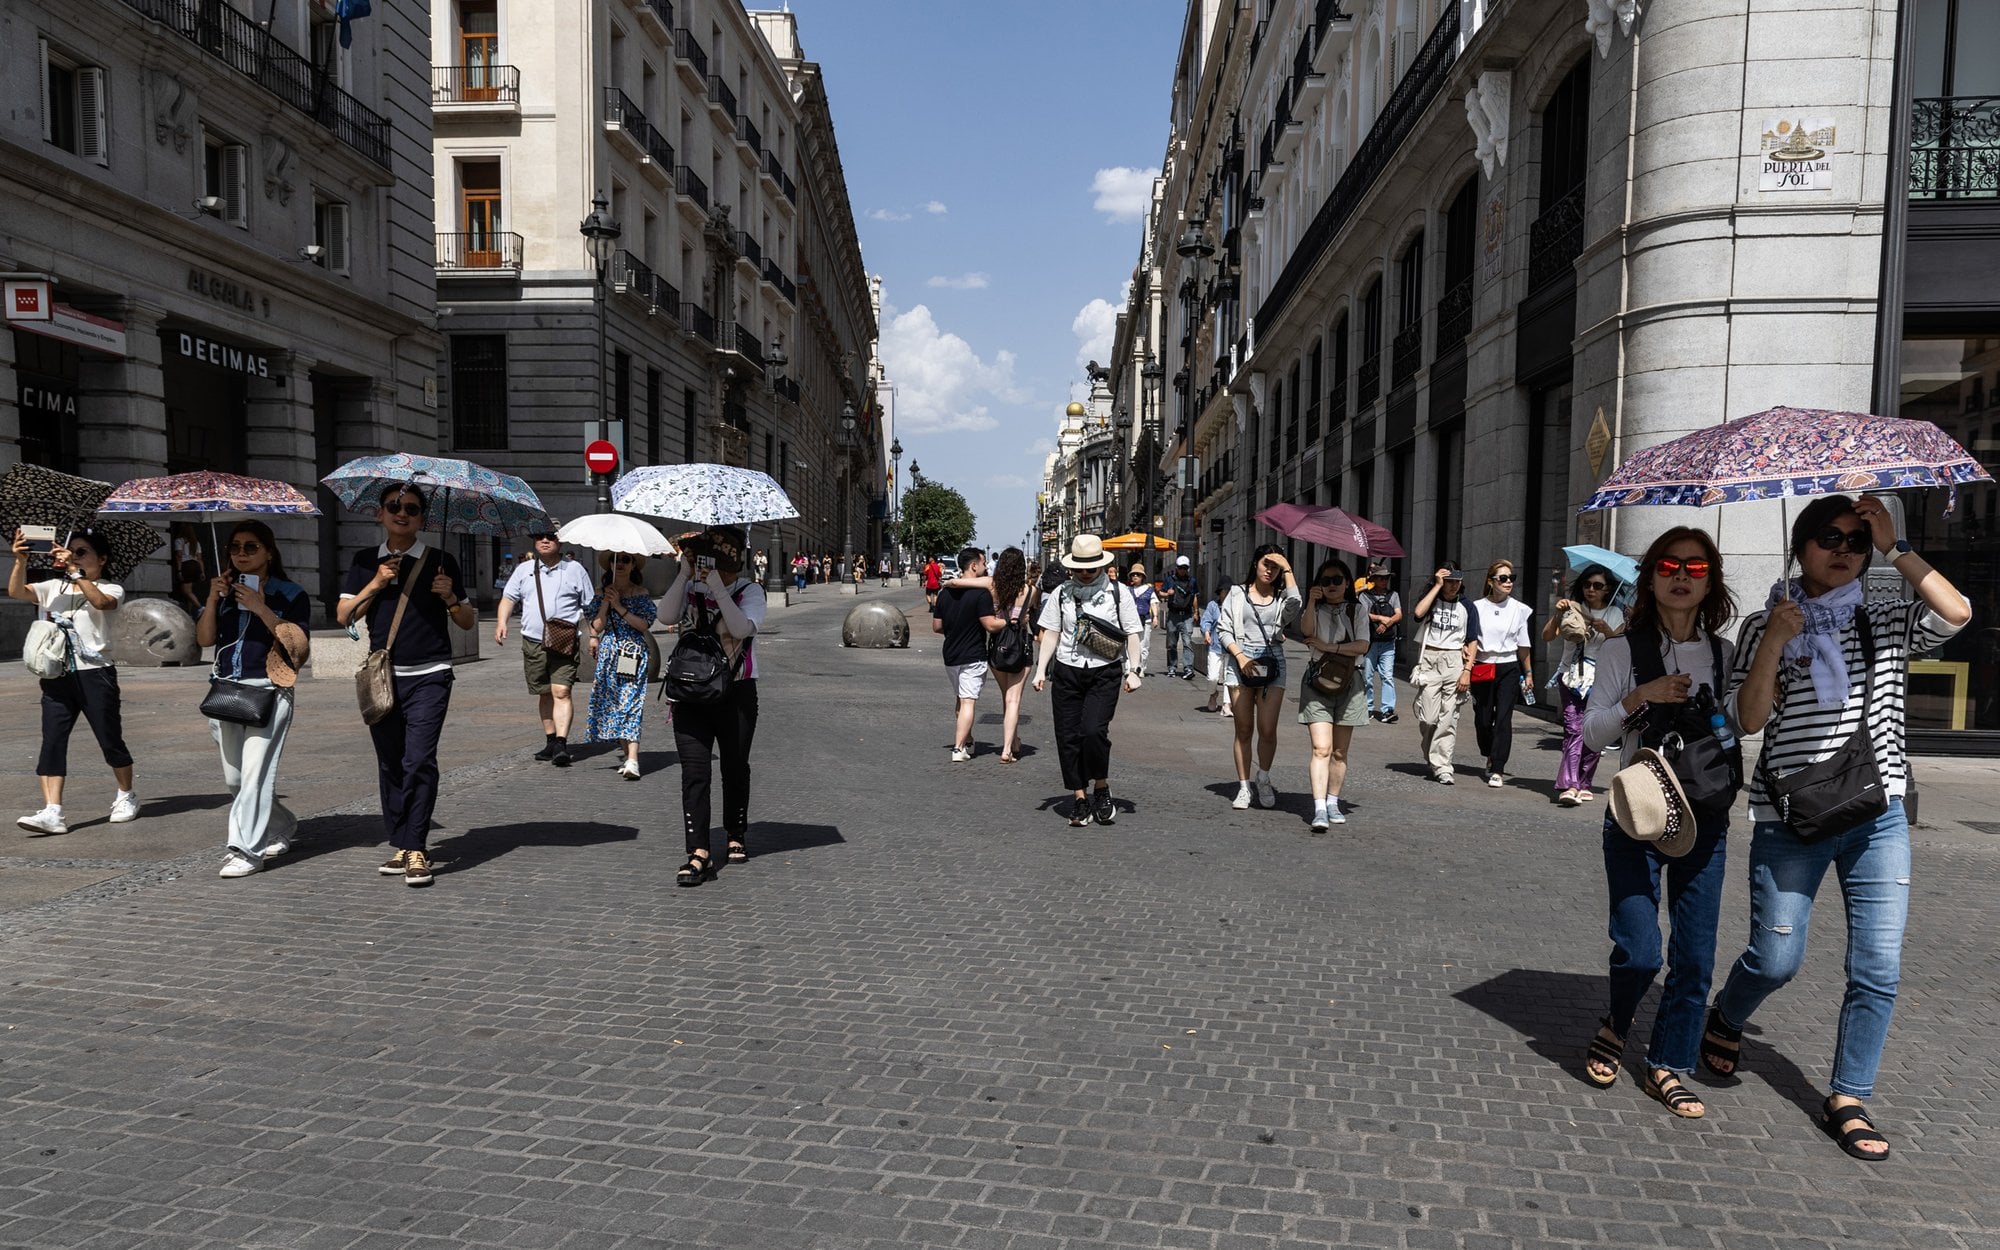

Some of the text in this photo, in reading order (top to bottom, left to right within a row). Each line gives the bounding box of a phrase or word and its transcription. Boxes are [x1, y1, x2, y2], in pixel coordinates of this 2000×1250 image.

[1764, 161, 1831, 174] PUERTA DEL
[1777, 172, 1809, 187] SOL
[180, 332, 268, 378] DECIMAS
[24, 387, 76, 415] CIMA
